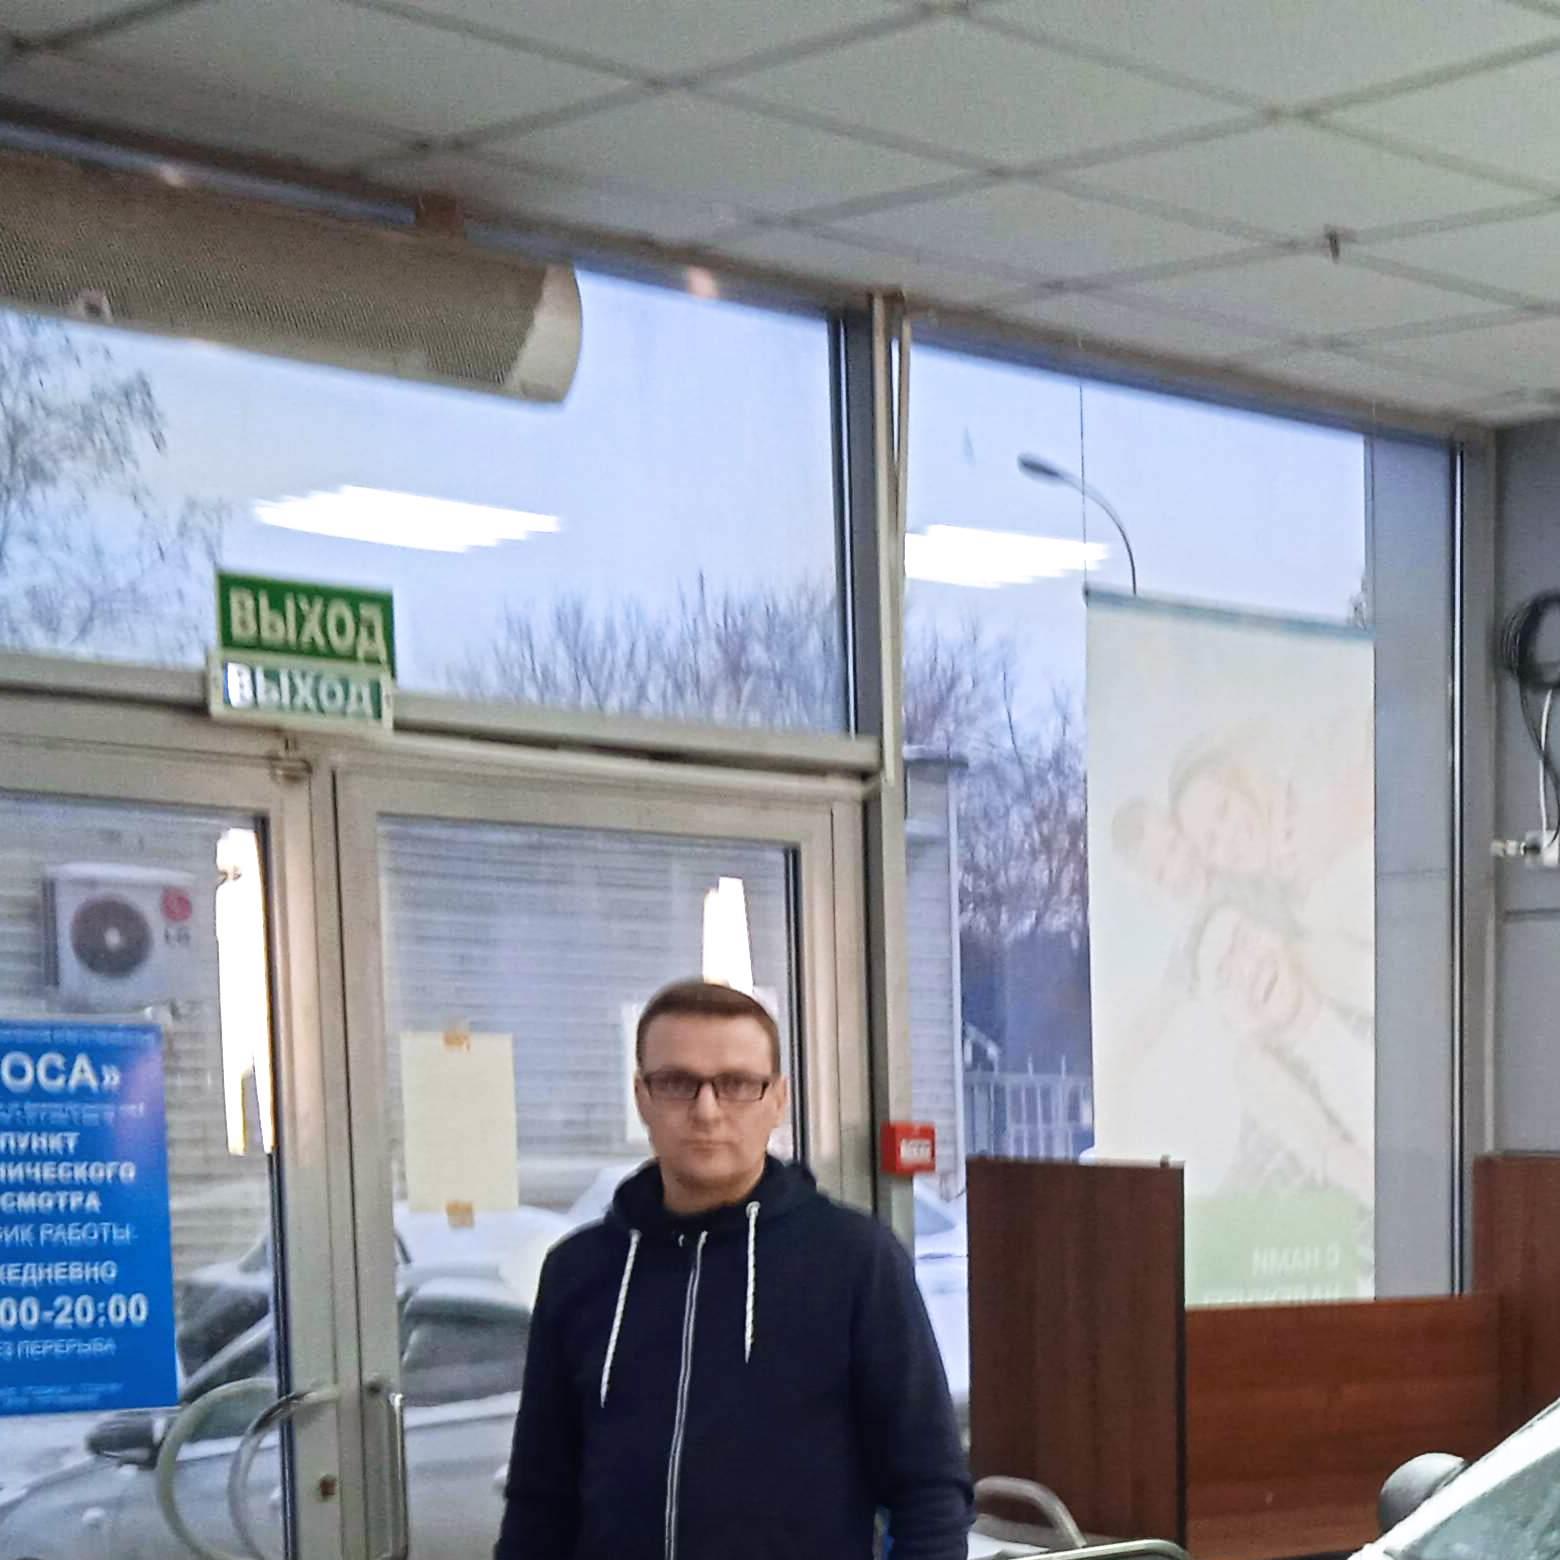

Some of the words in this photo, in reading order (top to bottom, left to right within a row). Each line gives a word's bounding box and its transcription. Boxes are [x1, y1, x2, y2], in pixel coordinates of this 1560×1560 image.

[229, 585, 388, 662] ВЫХОД
[227, 661, 374, 720] ВЫХОД
[0, 1131, 80, 1155] ПУНКТ
[0, 1223, 34, 1247] ИК
[0, 1293, 148, 1331] 00-20:00
